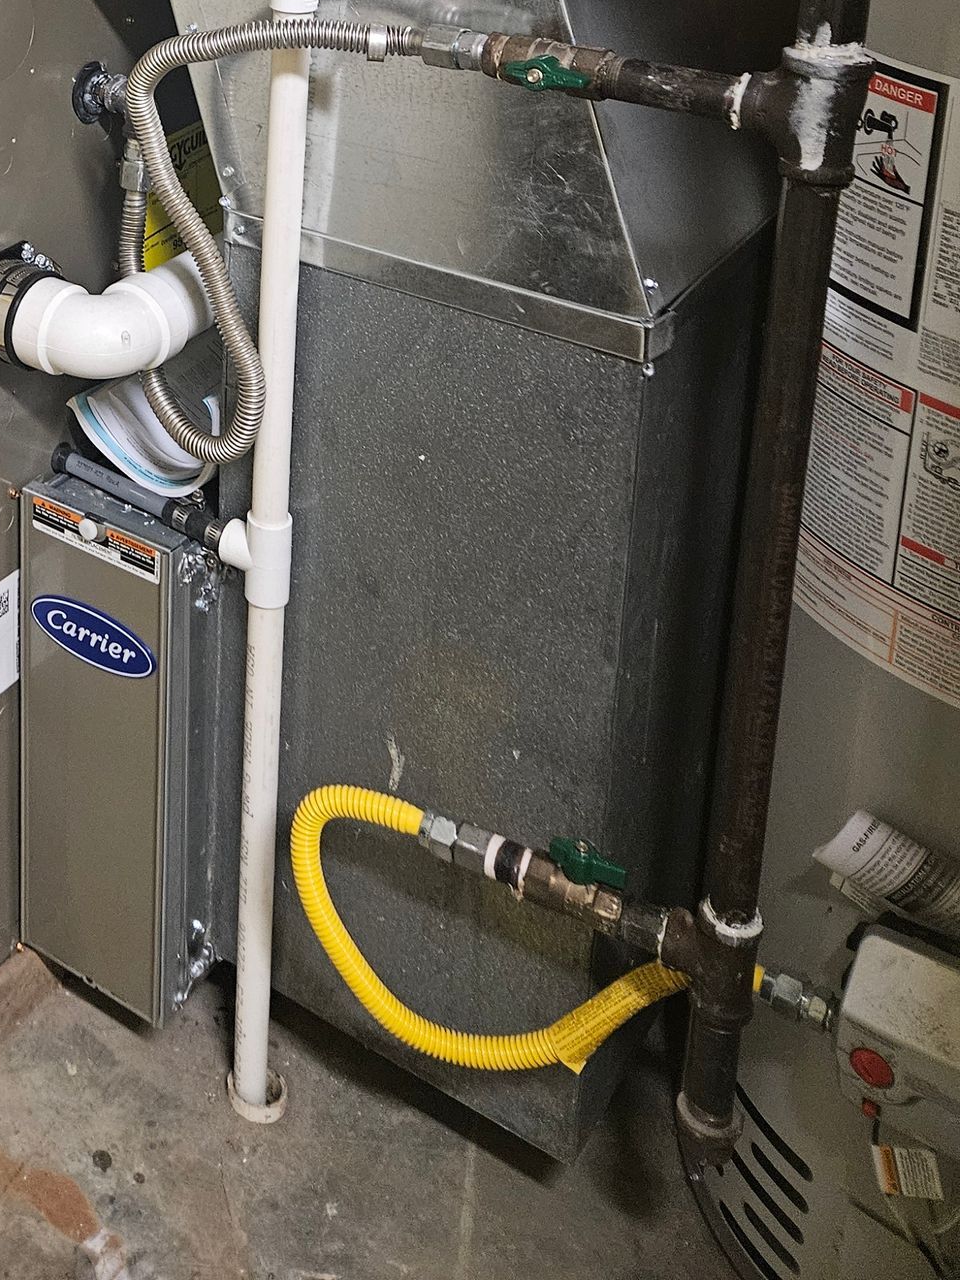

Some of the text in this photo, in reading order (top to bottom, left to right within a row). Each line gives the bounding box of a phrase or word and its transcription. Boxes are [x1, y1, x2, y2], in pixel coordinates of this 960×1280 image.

[874, 76, 924, 106] DANGER
[881, 143, 896, 157] HOT
[837, 365, 860, 382] BEFORE
[860, 379, 899, 402] OPERATING
[844, 361, 860, 375] YOUR
[861, 371, 886, 389] SAFETY
[46, 609, 137, 664] Carrier
